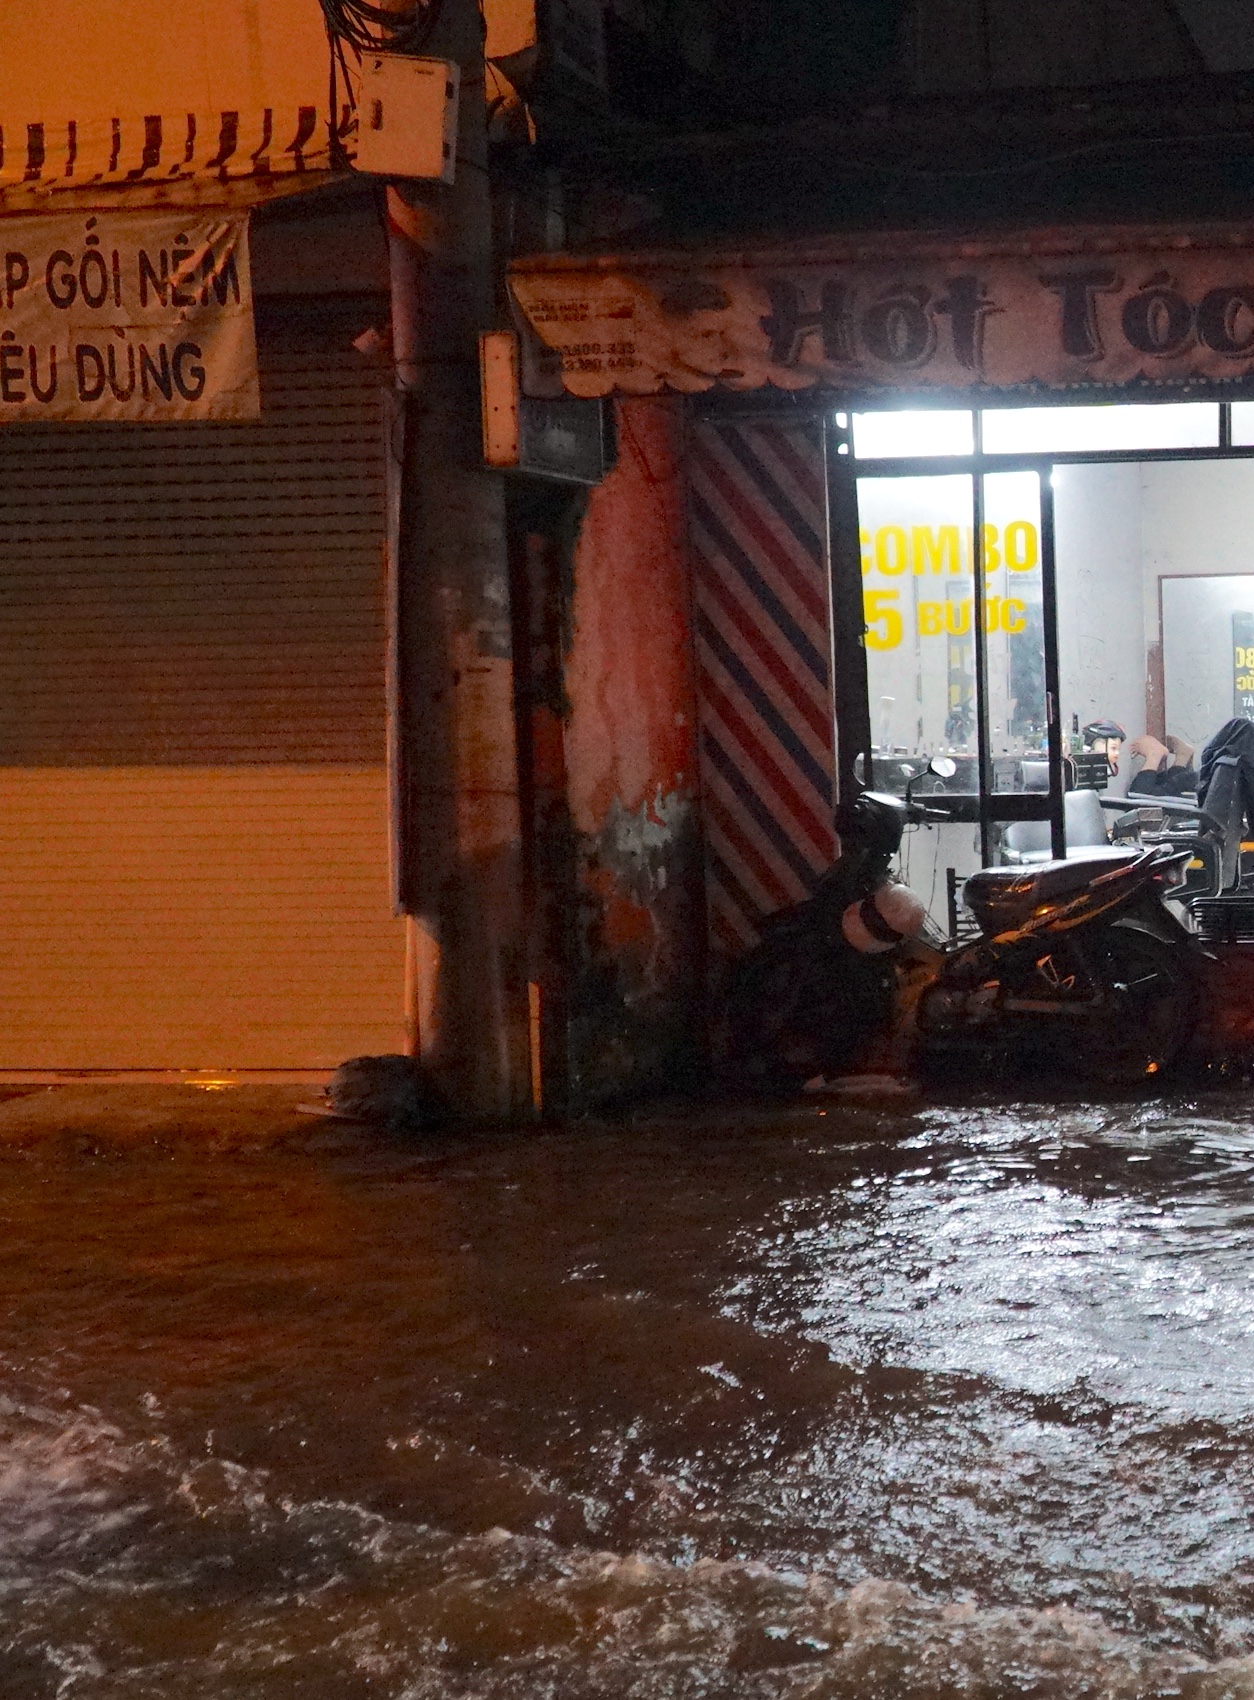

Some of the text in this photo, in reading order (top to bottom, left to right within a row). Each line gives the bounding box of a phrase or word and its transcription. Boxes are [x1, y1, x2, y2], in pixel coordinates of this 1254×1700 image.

[0, 251, 29, 309] P
[46, 216, 121, 309] GỐI
[76, 325, 206, 402] DÙNG
[864, 589, 905, 651] 5
